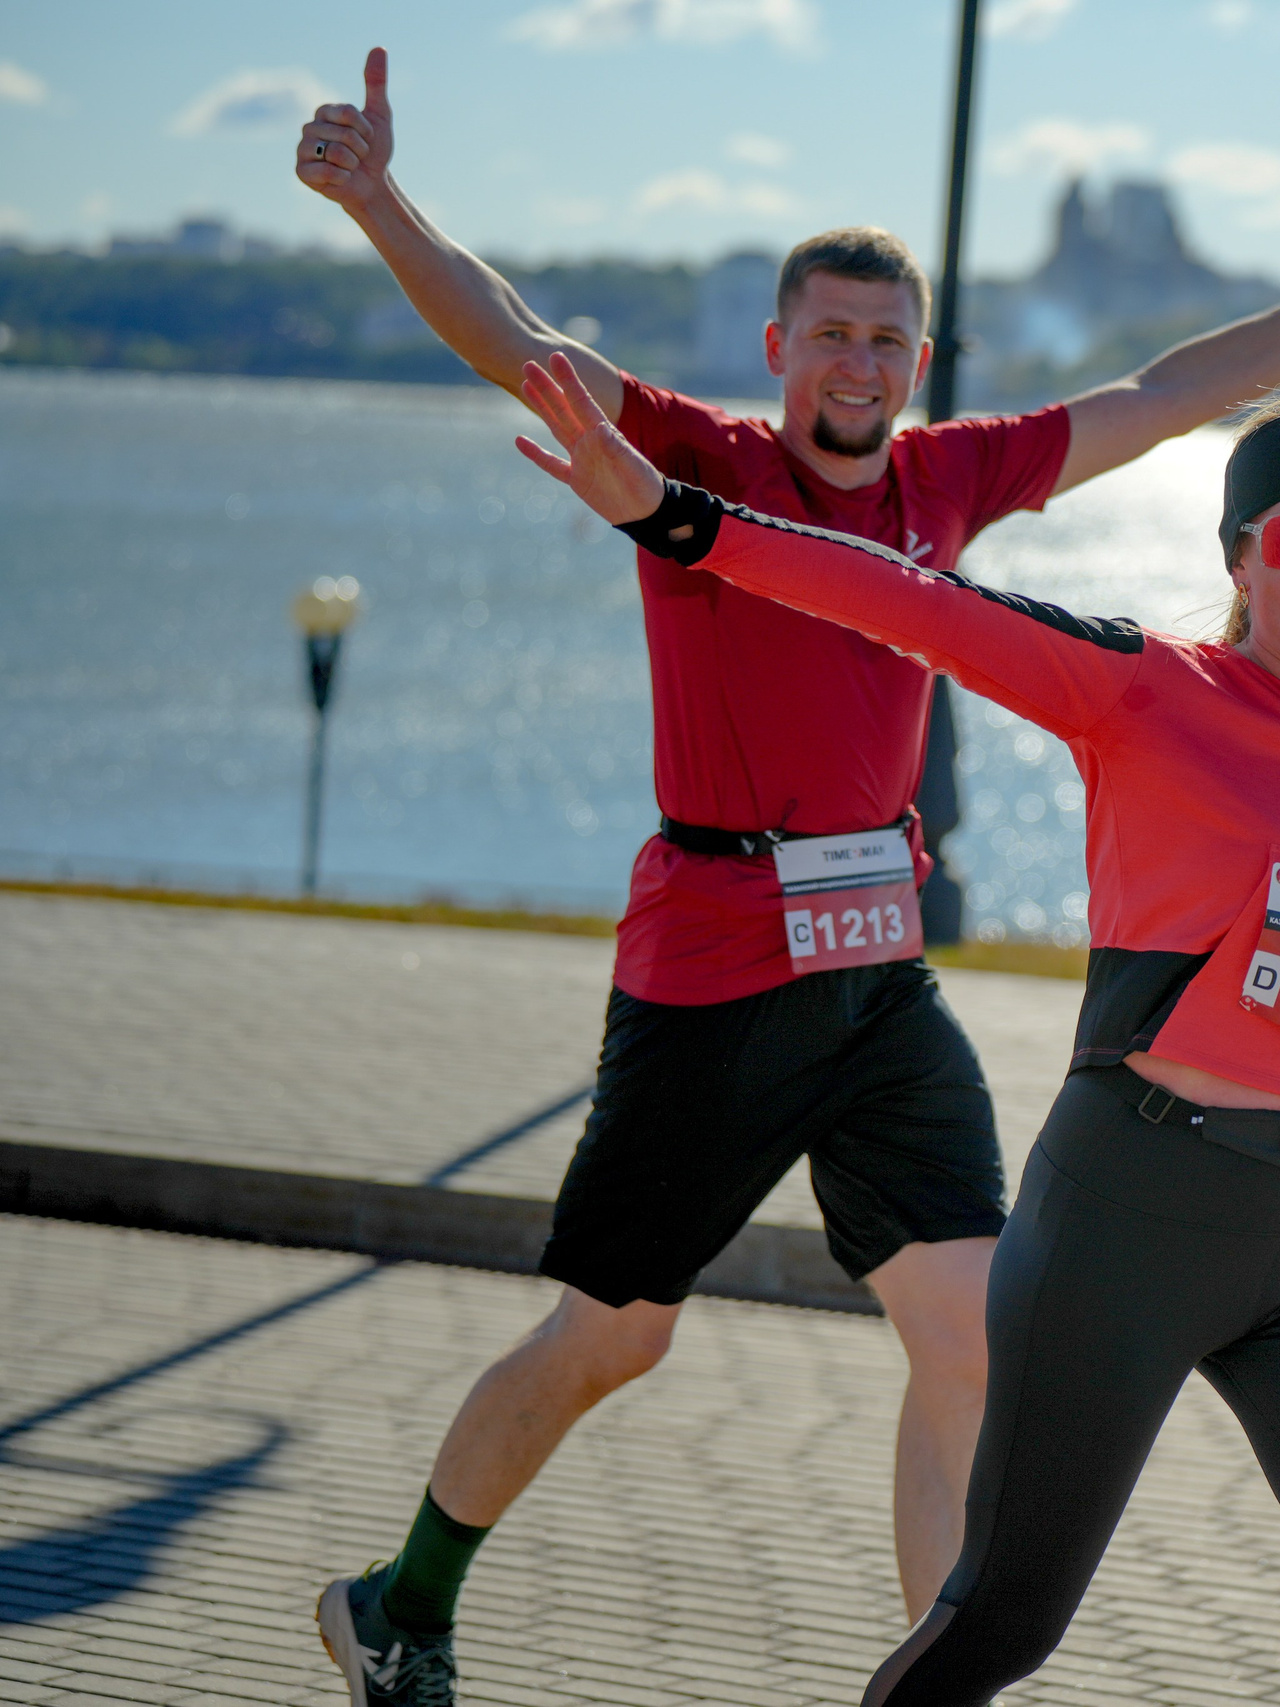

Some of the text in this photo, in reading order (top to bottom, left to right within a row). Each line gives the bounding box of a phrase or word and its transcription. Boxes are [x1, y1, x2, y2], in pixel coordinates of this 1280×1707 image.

[794, 903, 905, 951] C 1213
[1252, 965, 1278, 991] D
